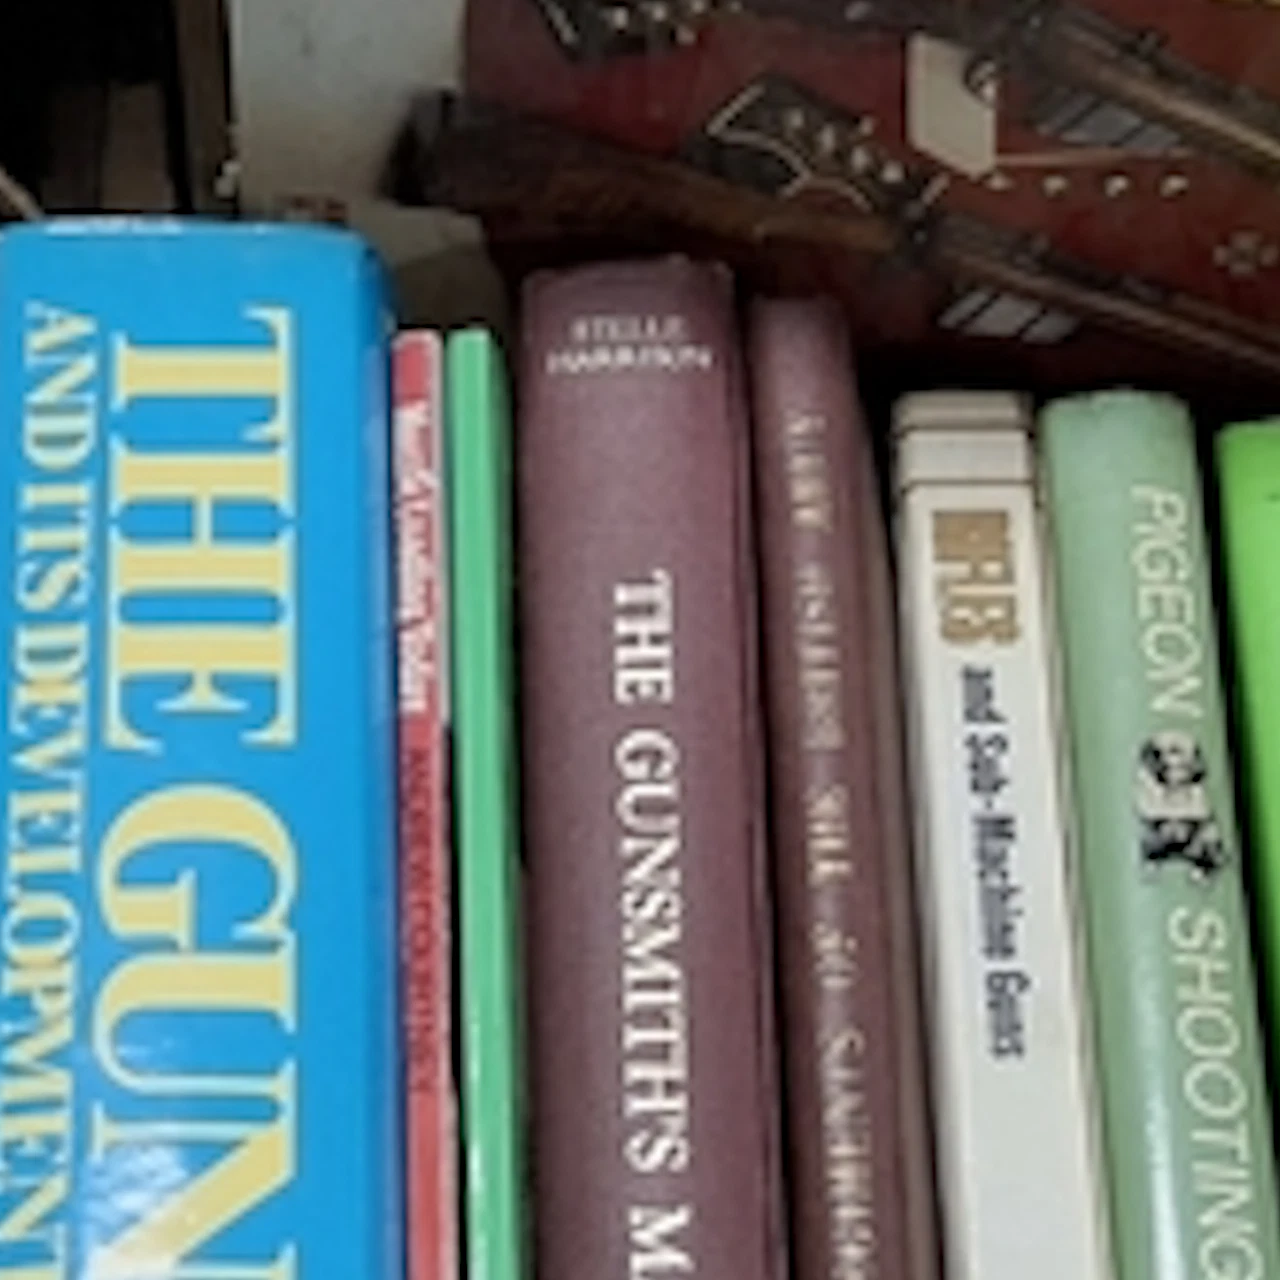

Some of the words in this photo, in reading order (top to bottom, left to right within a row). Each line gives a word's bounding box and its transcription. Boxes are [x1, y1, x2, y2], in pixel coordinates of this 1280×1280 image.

[22, 300, 100, 469] AND
[14, 480, 98, 614] ITS
[102, 303, 300, 756] THE
[613, 569, 674, 706] THE
[1129, 483, 1203, 718] PIGEON
[616, 728, 694, 1174] GUNSMITH'S
[961, 665, 1005, 725] and
[985, 969, 1032, 1062] Guns
